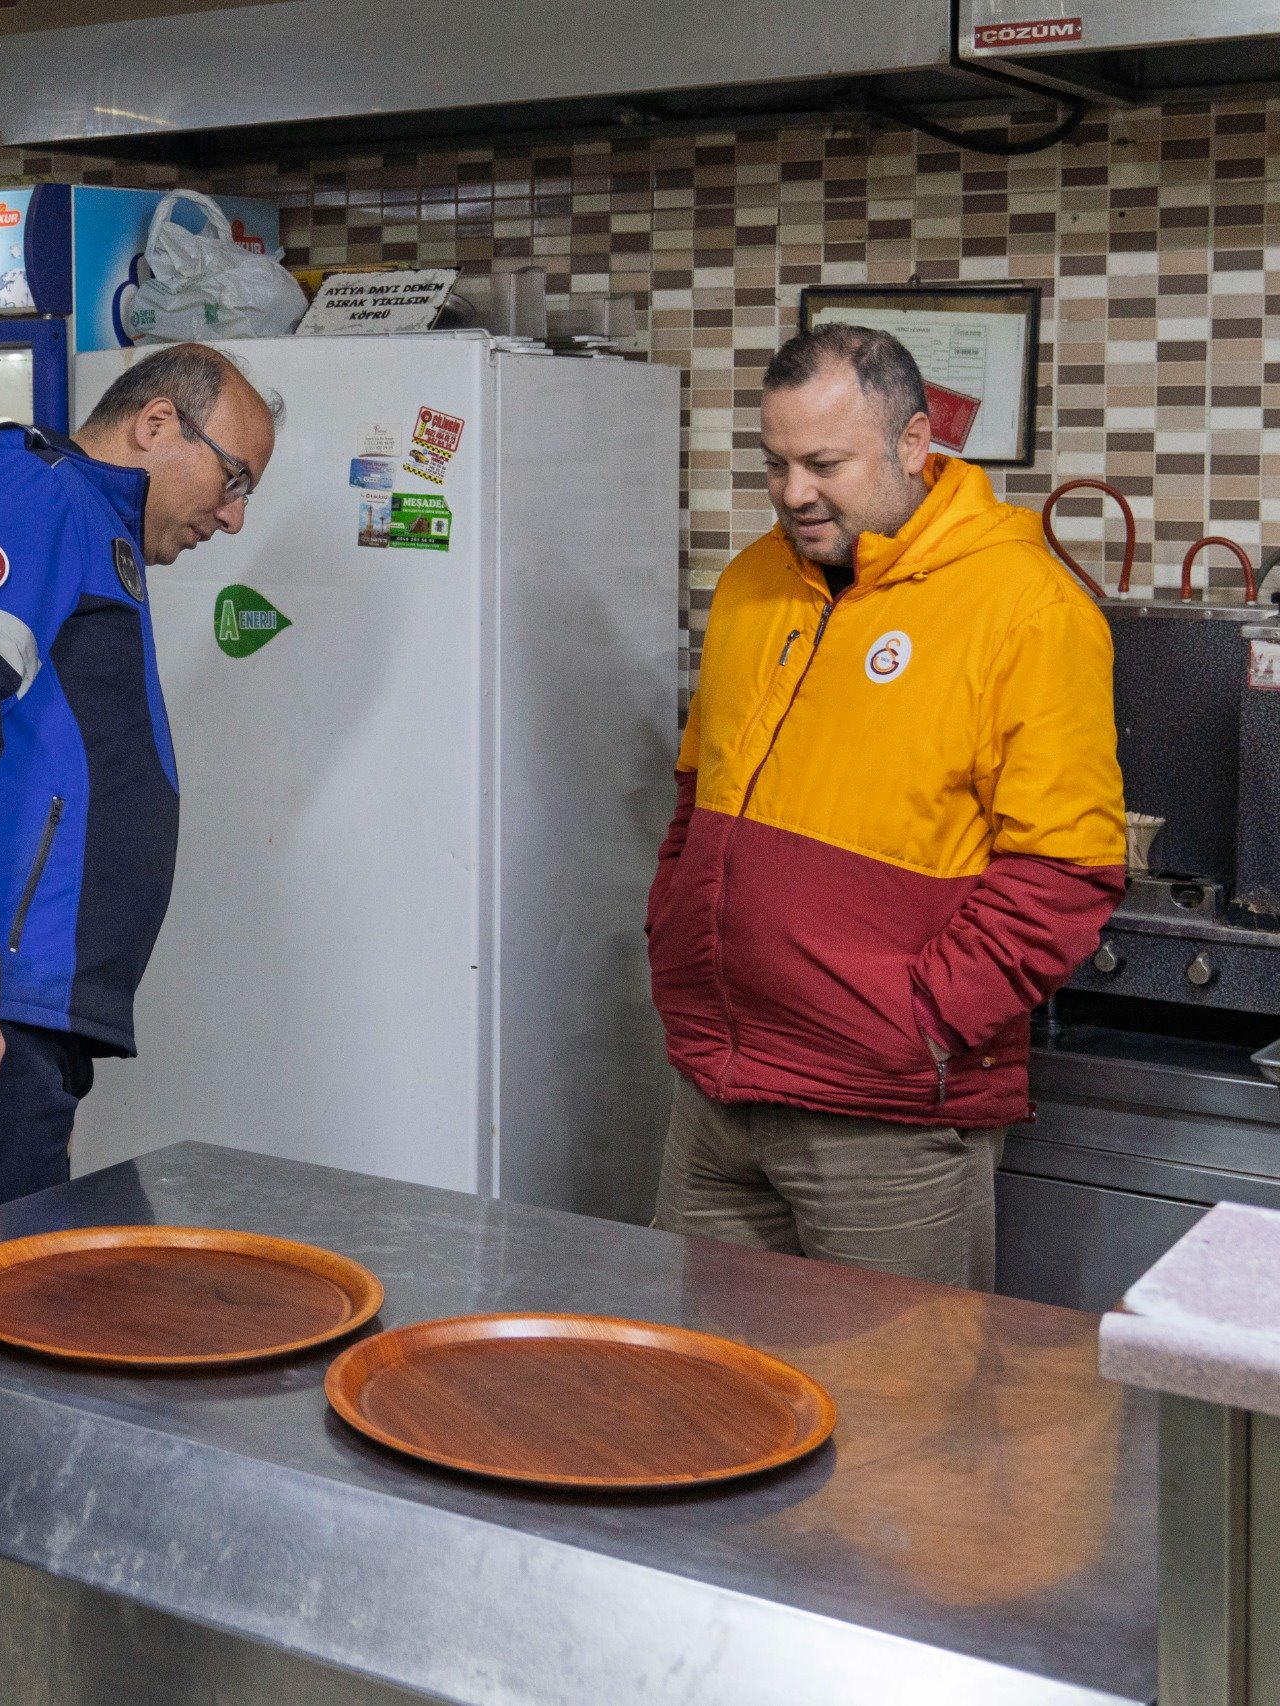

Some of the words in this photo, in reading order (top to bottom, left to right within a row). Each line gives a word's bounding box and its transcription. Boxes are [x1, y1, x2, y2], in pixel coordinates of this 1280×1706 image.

[981, 22, 1074, 44] ÇÖZÜM
[368, 284, 401, 296] DAYI
[402, 282, 444, 294] DEMEM
[325, 298, 369, 310] BIRAK
[349, 309, 390, 321] KÖPRÜ
